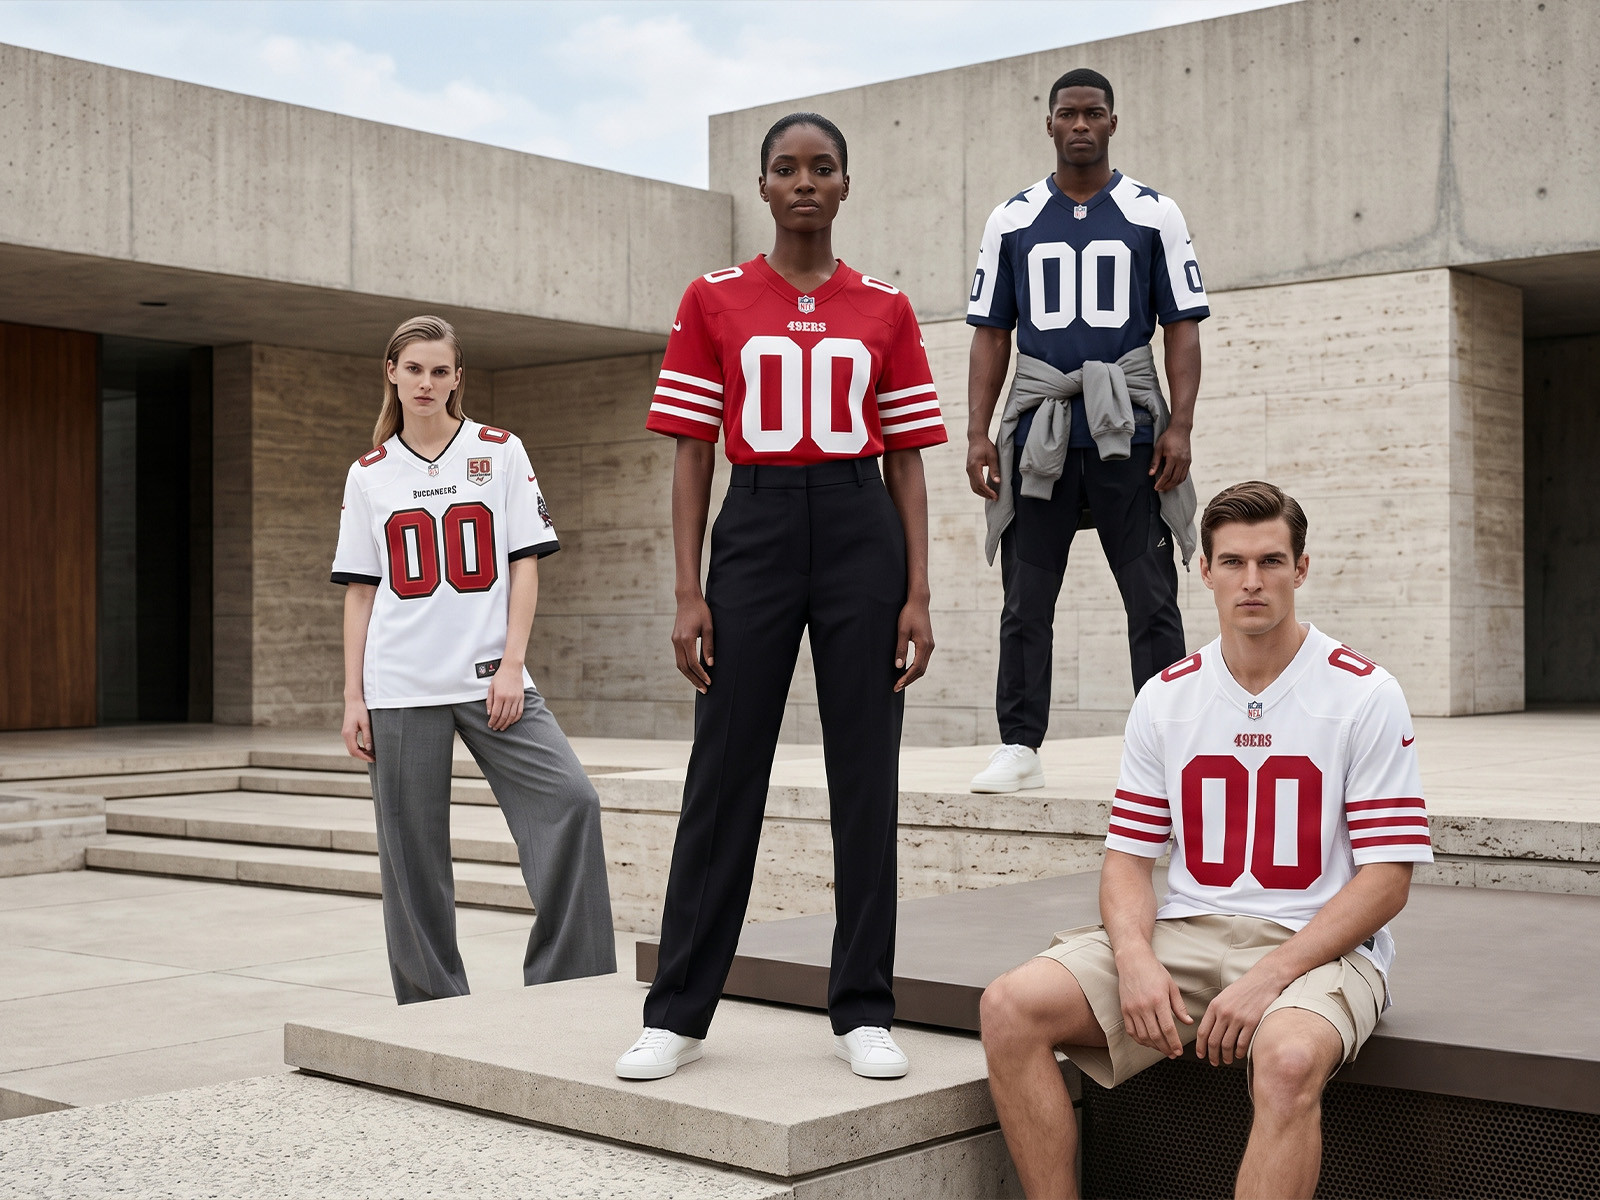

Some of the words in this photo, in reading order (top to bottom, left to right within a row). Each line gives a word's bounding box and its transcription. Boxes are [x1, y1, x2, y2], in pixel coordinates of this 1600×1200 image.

[703, 266, 744, 284] 0
[861, 275, 900, 295] 0
[1027, 239, 1131, 332] 00
[786, 320, 827, 333] 49ERS
[740, 335, 872, 454] 00
[478, 426, 511, 444] 0
[469, 459, 491, 474] 50
[412, 484, 457, 499] BUCCANEERS
[384, 501, 498, 599] 00
[1233, 733, 1273, 748] 49ERS
[1181, 754, 1323, 890] 00
